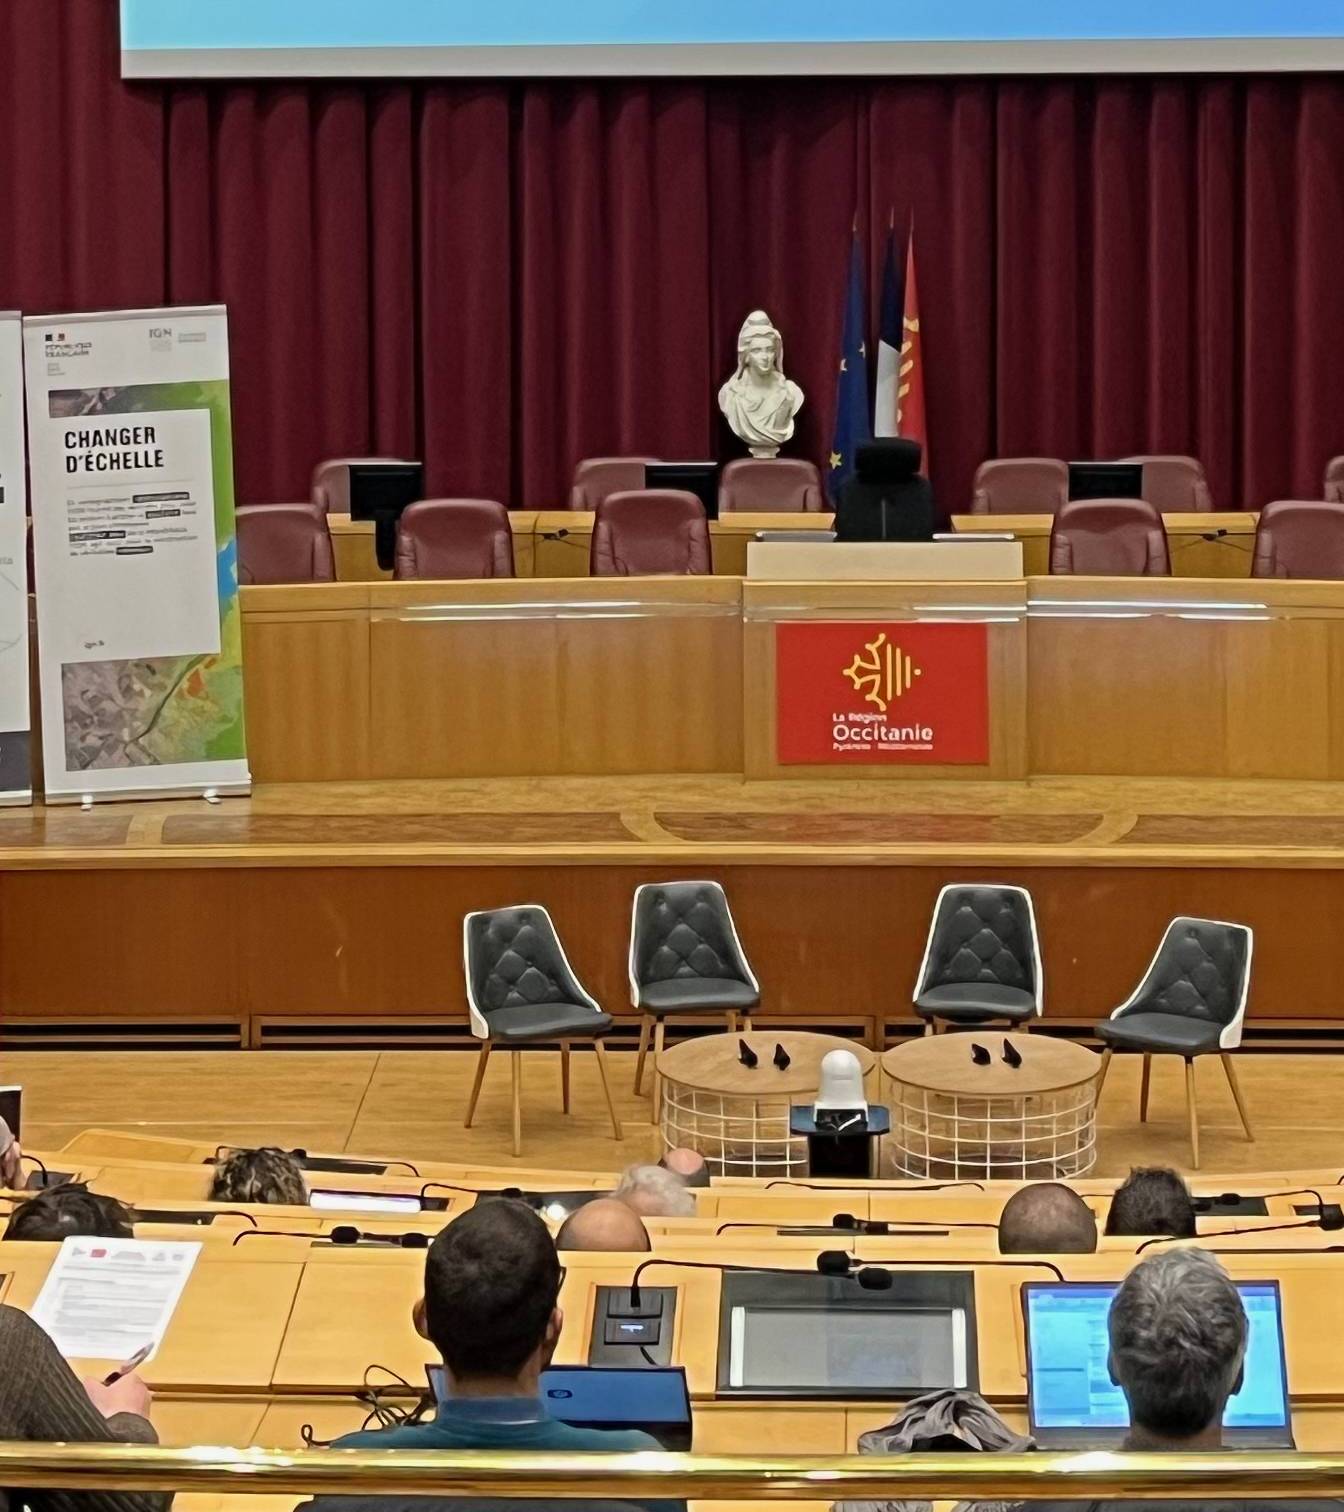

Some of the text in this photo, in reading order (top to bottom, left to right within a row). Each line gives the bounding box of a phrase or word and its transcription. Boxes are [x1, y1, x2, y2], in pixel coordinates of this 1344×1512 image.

[64, 426, 156, 450] CHANGER
[66, 449, 165, 474] D'ÉCHELLE
[832, 722, 934, 742] Occitanie
